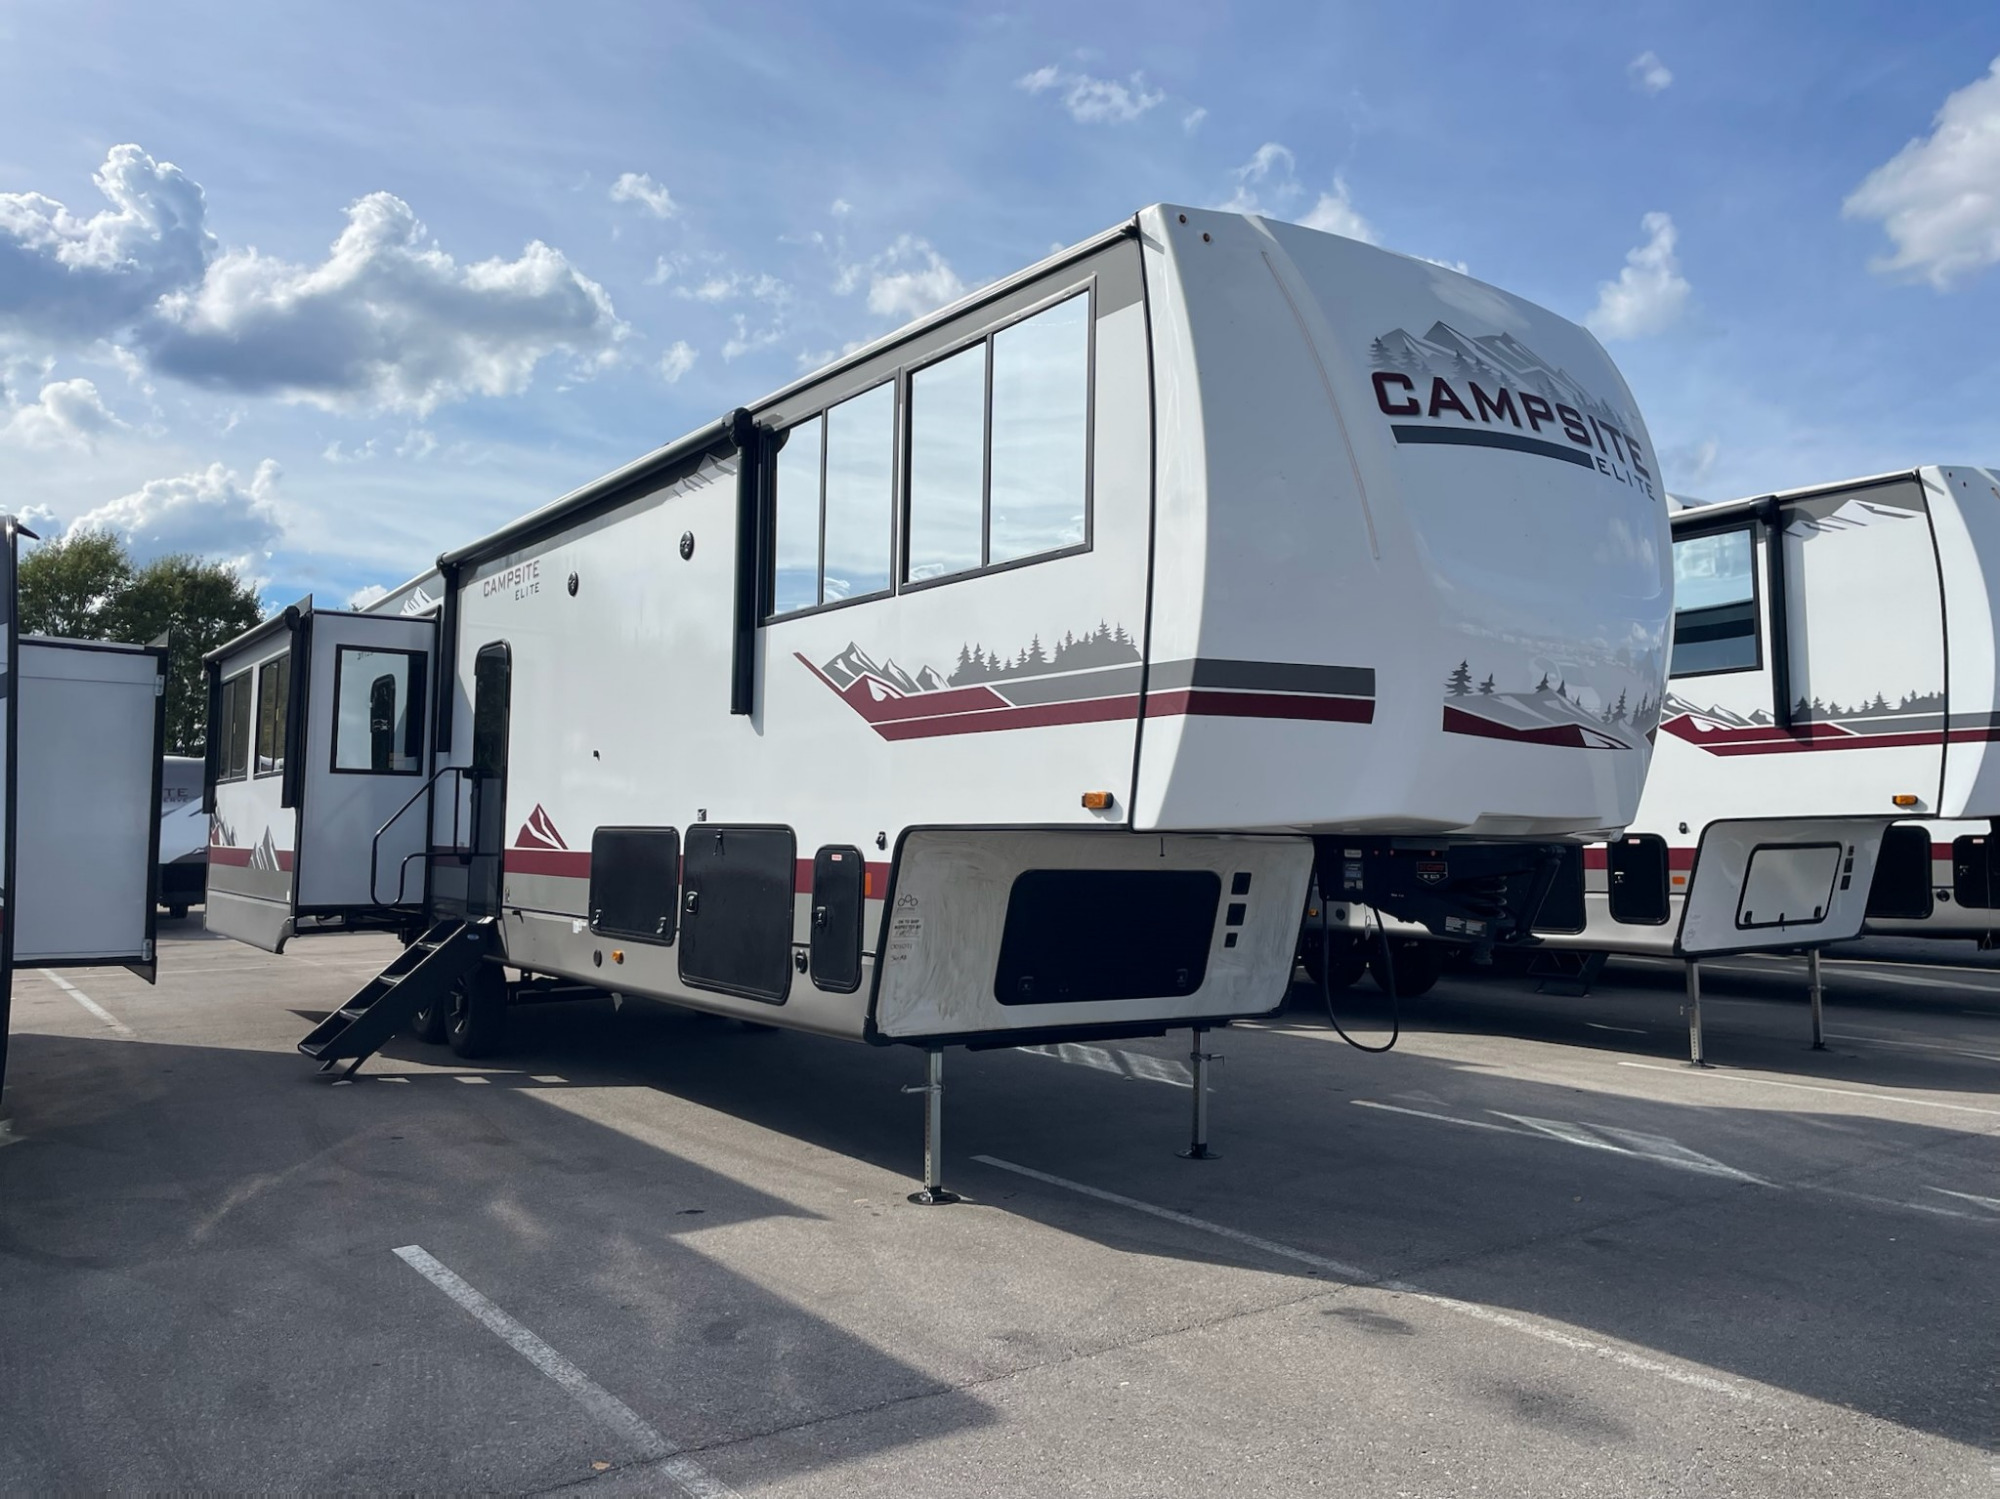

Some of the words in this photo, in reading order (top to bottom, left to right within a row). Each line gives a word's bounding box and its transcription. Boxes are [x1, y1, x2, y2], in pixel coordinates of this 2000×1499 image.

[1371, 371, 1651, 481] CAMPSITE
[1596, 456, 1656, 501] ELITE
[483, 560, 540, 598] CAMPSITE
[515, 582, 540, 601] ELITE
